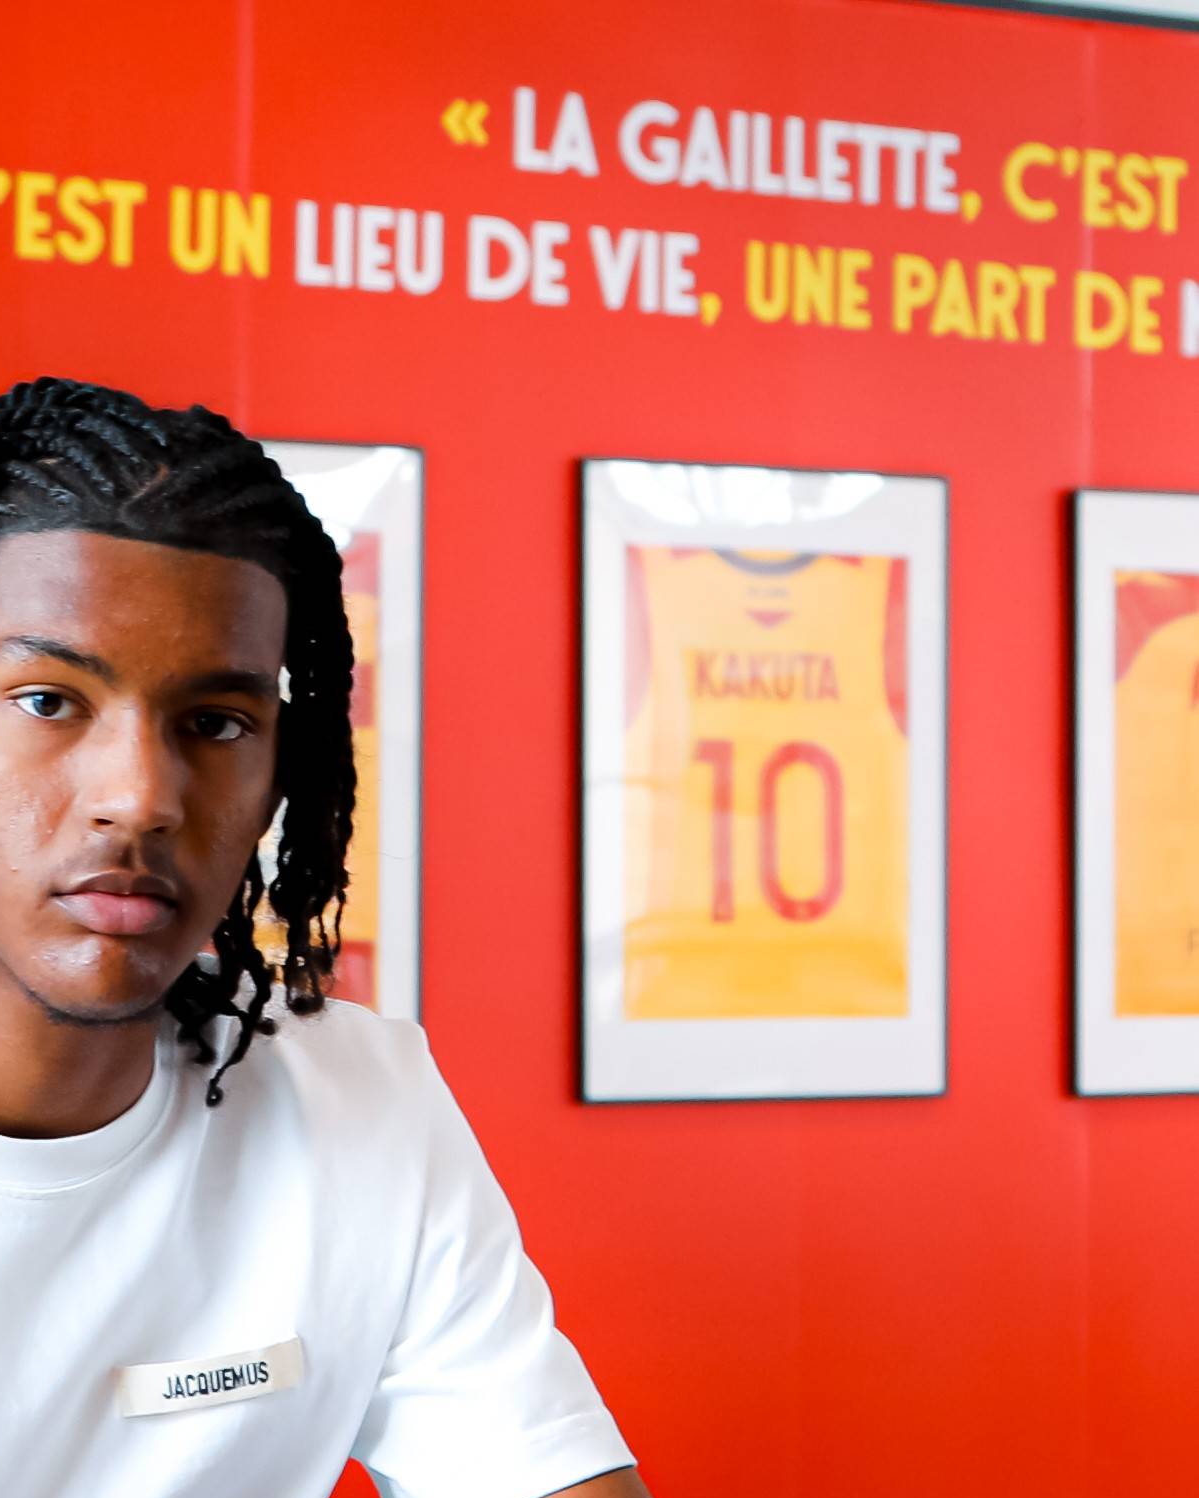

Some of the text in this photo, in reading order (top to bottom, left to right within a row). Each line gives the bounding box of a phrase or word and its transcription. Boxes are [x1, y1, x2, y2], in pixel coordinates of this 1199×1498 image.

[513, 87, 600, 177] LA
[618, 100, 982, 222] GAILLETTE,
[1003, 142, 1189, 234] C'EST
[170, 186, 271, 279] UN
[295, 199, 445, 296] LIEU
[467, 214, 571, 307] DE
[588, 225, 722, 326] VIE,
[746, 239, 873, 331] UNE
[893, 253, 1057, 345] PART
[1073, 269, 1164, 355] DE
[694, 651, 840, 701] KAKUTA
[692, 737, 845, 924] 10
[163, 1361, 269, 1400] JACQUEMUS
